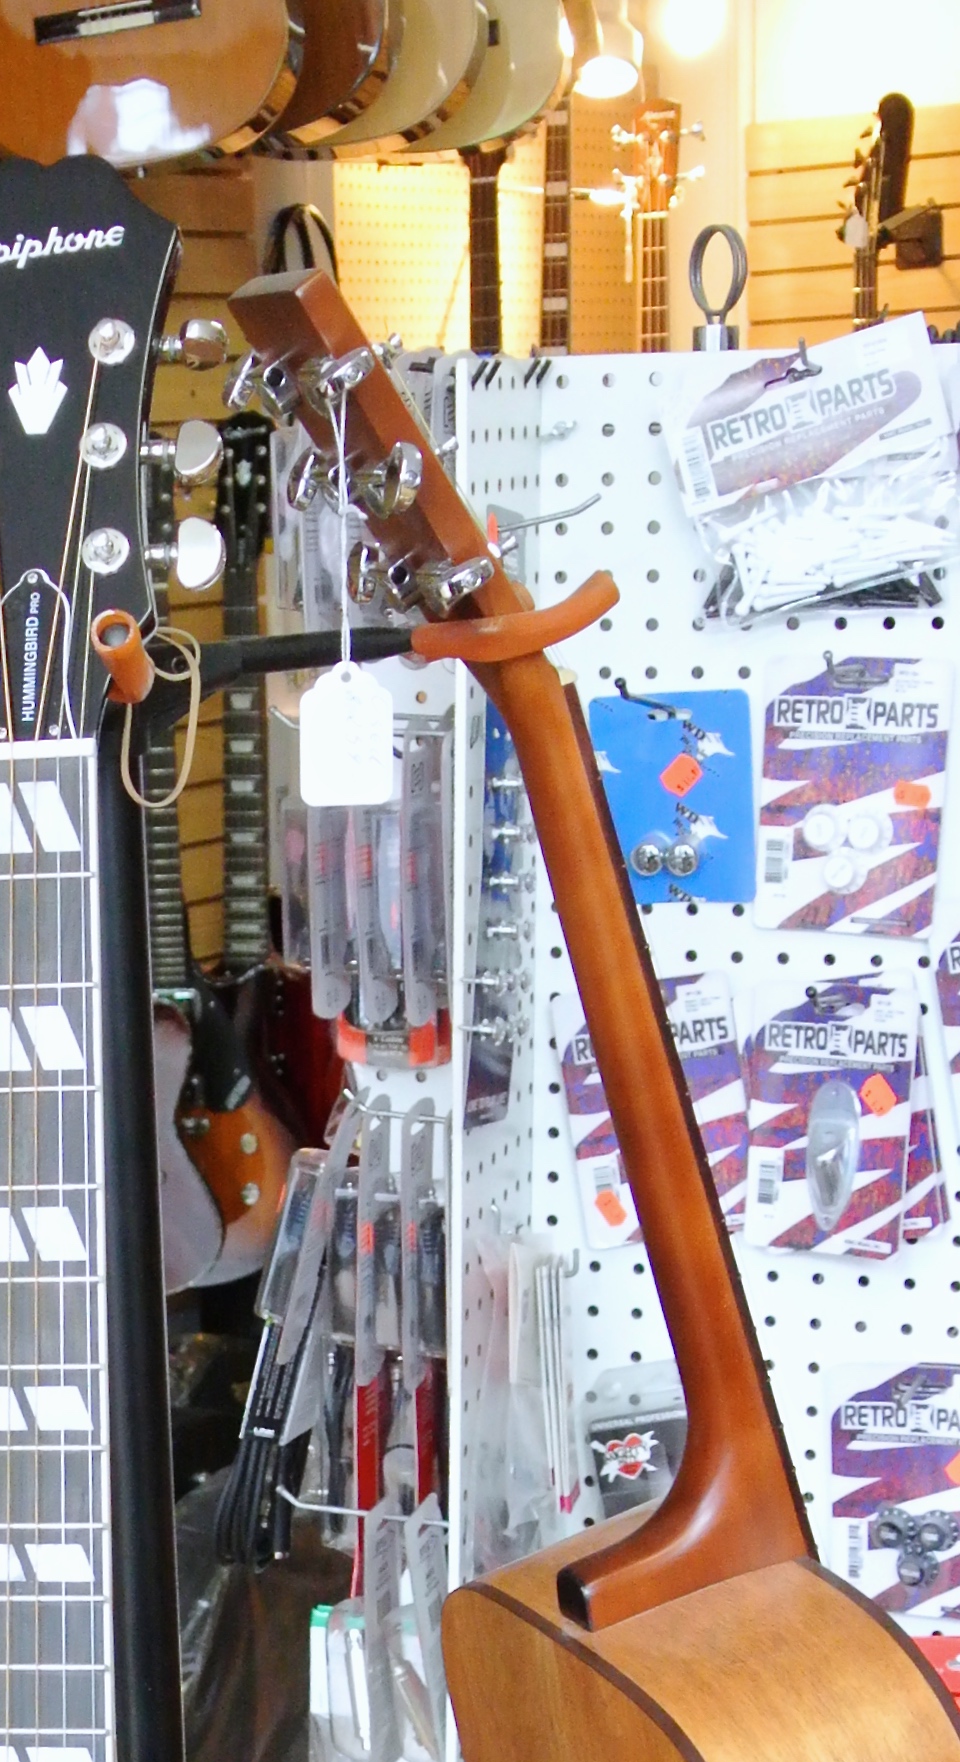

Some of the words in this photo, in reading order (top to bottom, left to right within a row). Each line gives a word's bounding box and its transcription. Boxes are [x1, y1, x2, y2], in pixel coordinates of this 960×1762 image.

[710, 404, 787, 450] RETRO
[817, 368, 893, 416] PARTS
[854, 407, 885, 422] PARTS
[21, 616, 39, 721] HUMMINGBIRD
[30, 592, 40, 614] PRO
[777, 699, 844, 724] RETRO
[873, 701, 939, 728] PARTS
[682, 720, 706, 741] WD
[676, 802, 699, 823] WD
[768, 1024, 828, 1050] RETRO
[853, 1029, 908, 1058] PARTS
[844, 1405, 908, 1428] RETRO
